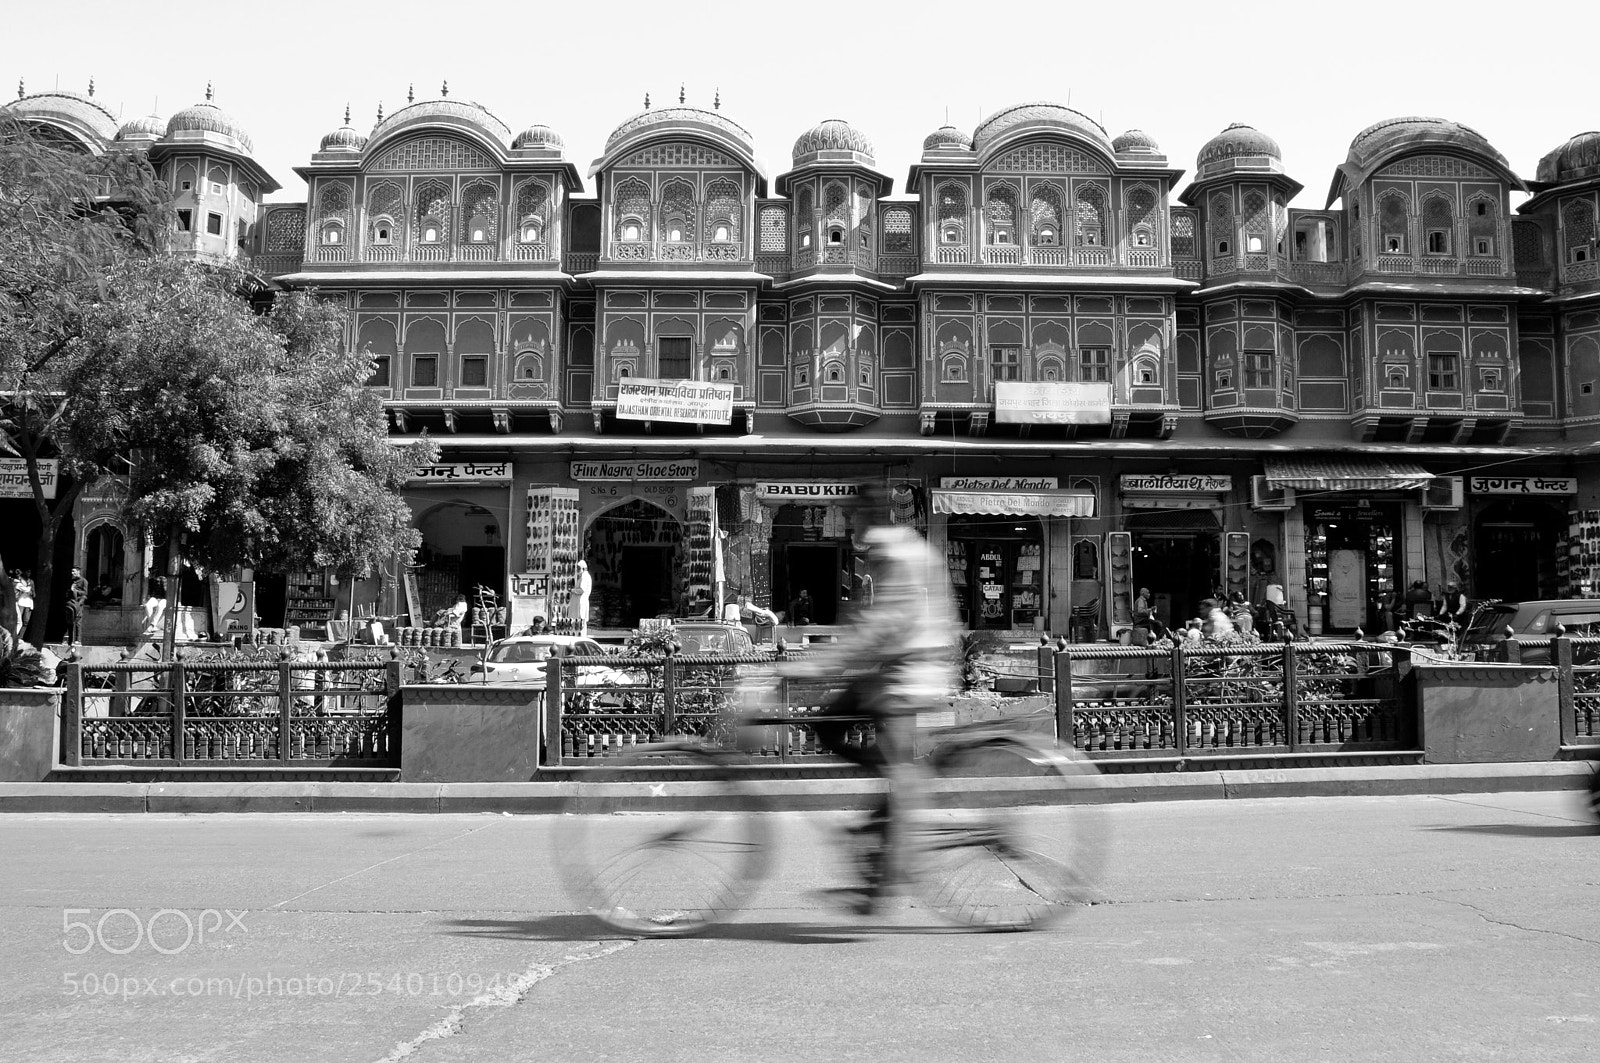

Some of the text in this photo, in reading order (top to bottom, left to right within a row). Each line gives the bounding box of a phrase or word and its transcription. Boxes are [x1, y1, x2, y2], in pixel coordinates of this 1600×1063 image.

[621, 384, 657, 397] राजस्थान
[618, 404, 649, 416] RAJASTHAN
[649, 406, 673, 418] ORIENTAL
[673, 407, 698, 419] RESEARCH
[572, 463, 697, 477] Fine Nagra Shoe Store
[990, 478, 1011, 489] Del
[1012, 478, 1053, 489] Mondo
[1473, 477, 1530, 493] जुगनू
[610, 486, 617, 496] 6
[644, 486, 676, 495] OLD SHOP
[766, 485, 821, 496] BABU
[823, 485, 861, 496] KHA
[1007, 498, 1021, 507] Del
[1023, 498, 1050, 507] Mondo
[980, 553, 1002, 561] ABDUL
